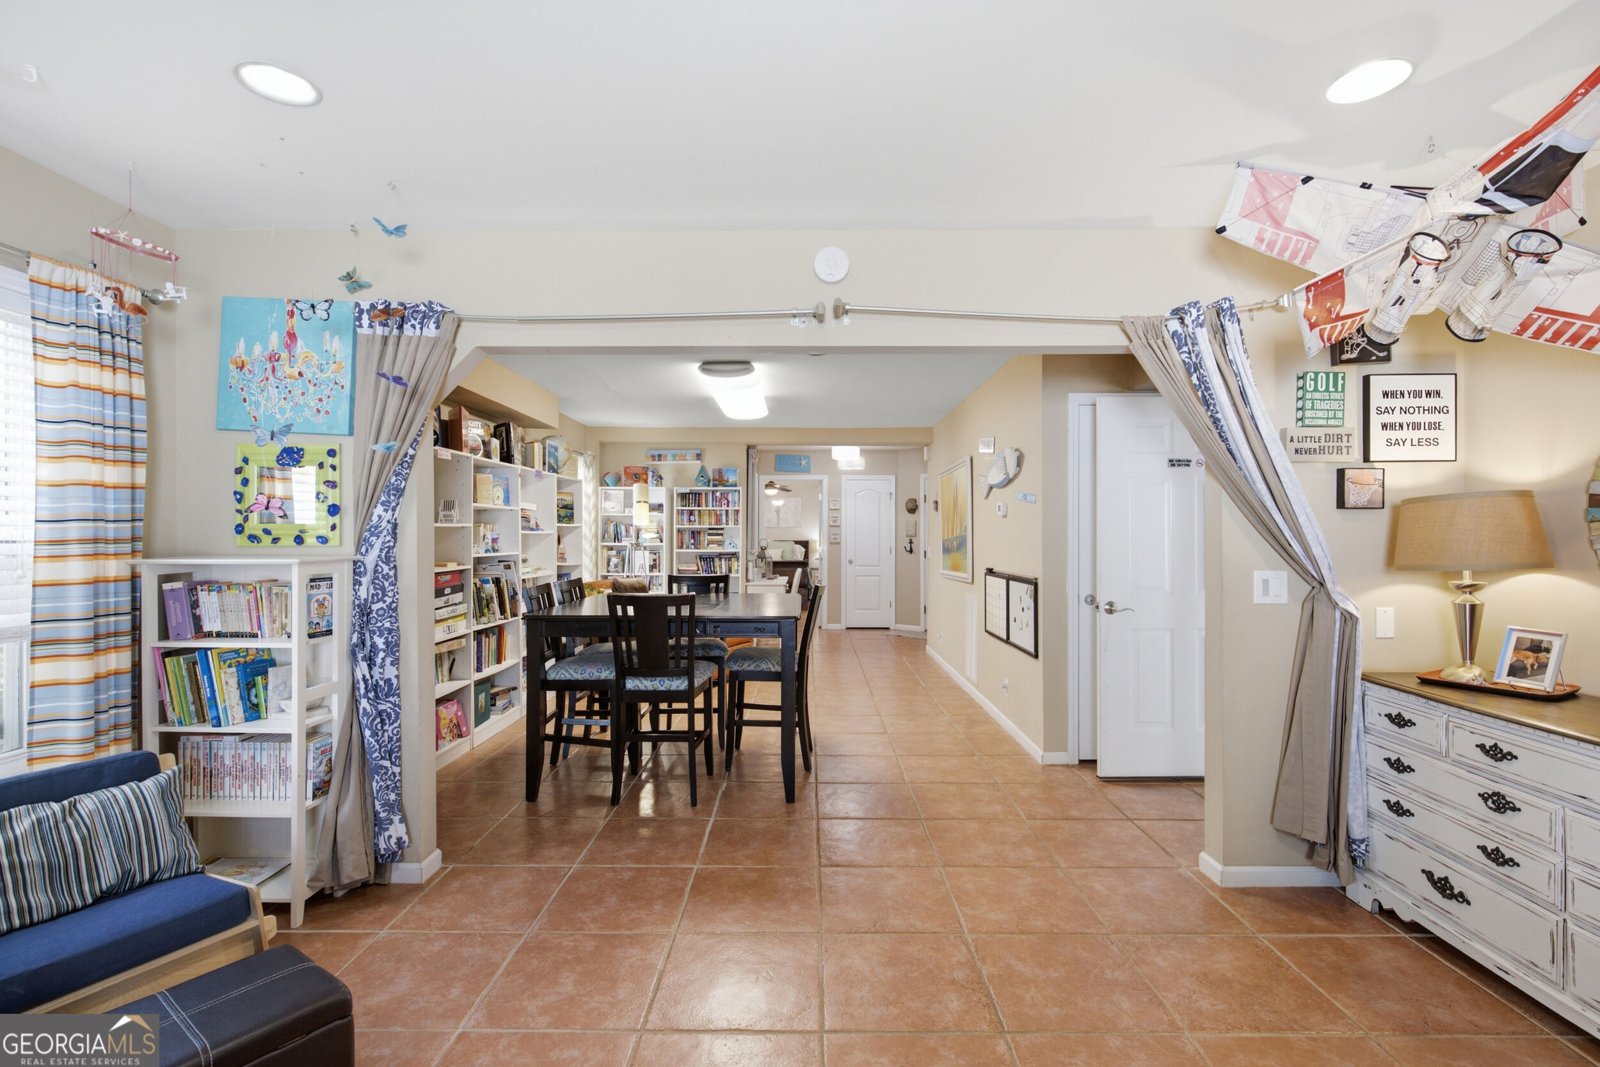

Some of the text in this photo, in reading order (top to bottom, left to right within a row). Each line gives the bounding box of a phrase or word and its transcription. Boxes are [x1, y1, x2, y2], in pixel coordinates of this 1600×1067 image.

[1306, 372, 1344, 391] GOLF
[1381, 389, 1405, 399] WHEN
[1407, 389, 1423, 399] YOU
[1305, 400, 1344, 410] OF TRAGEDIES
[1375, 405, 1450, 415] SAY NOTHING
[1380, 421, 1404, 431] WHEN
[1405, 421, 1422, 431] YOU
[1289, 433, 1353, 443] A LITTLE DIRT
[1385, 437, 1440, 447] SAY LESS
[1294, 445, 1353, 455] NEVER HURT
